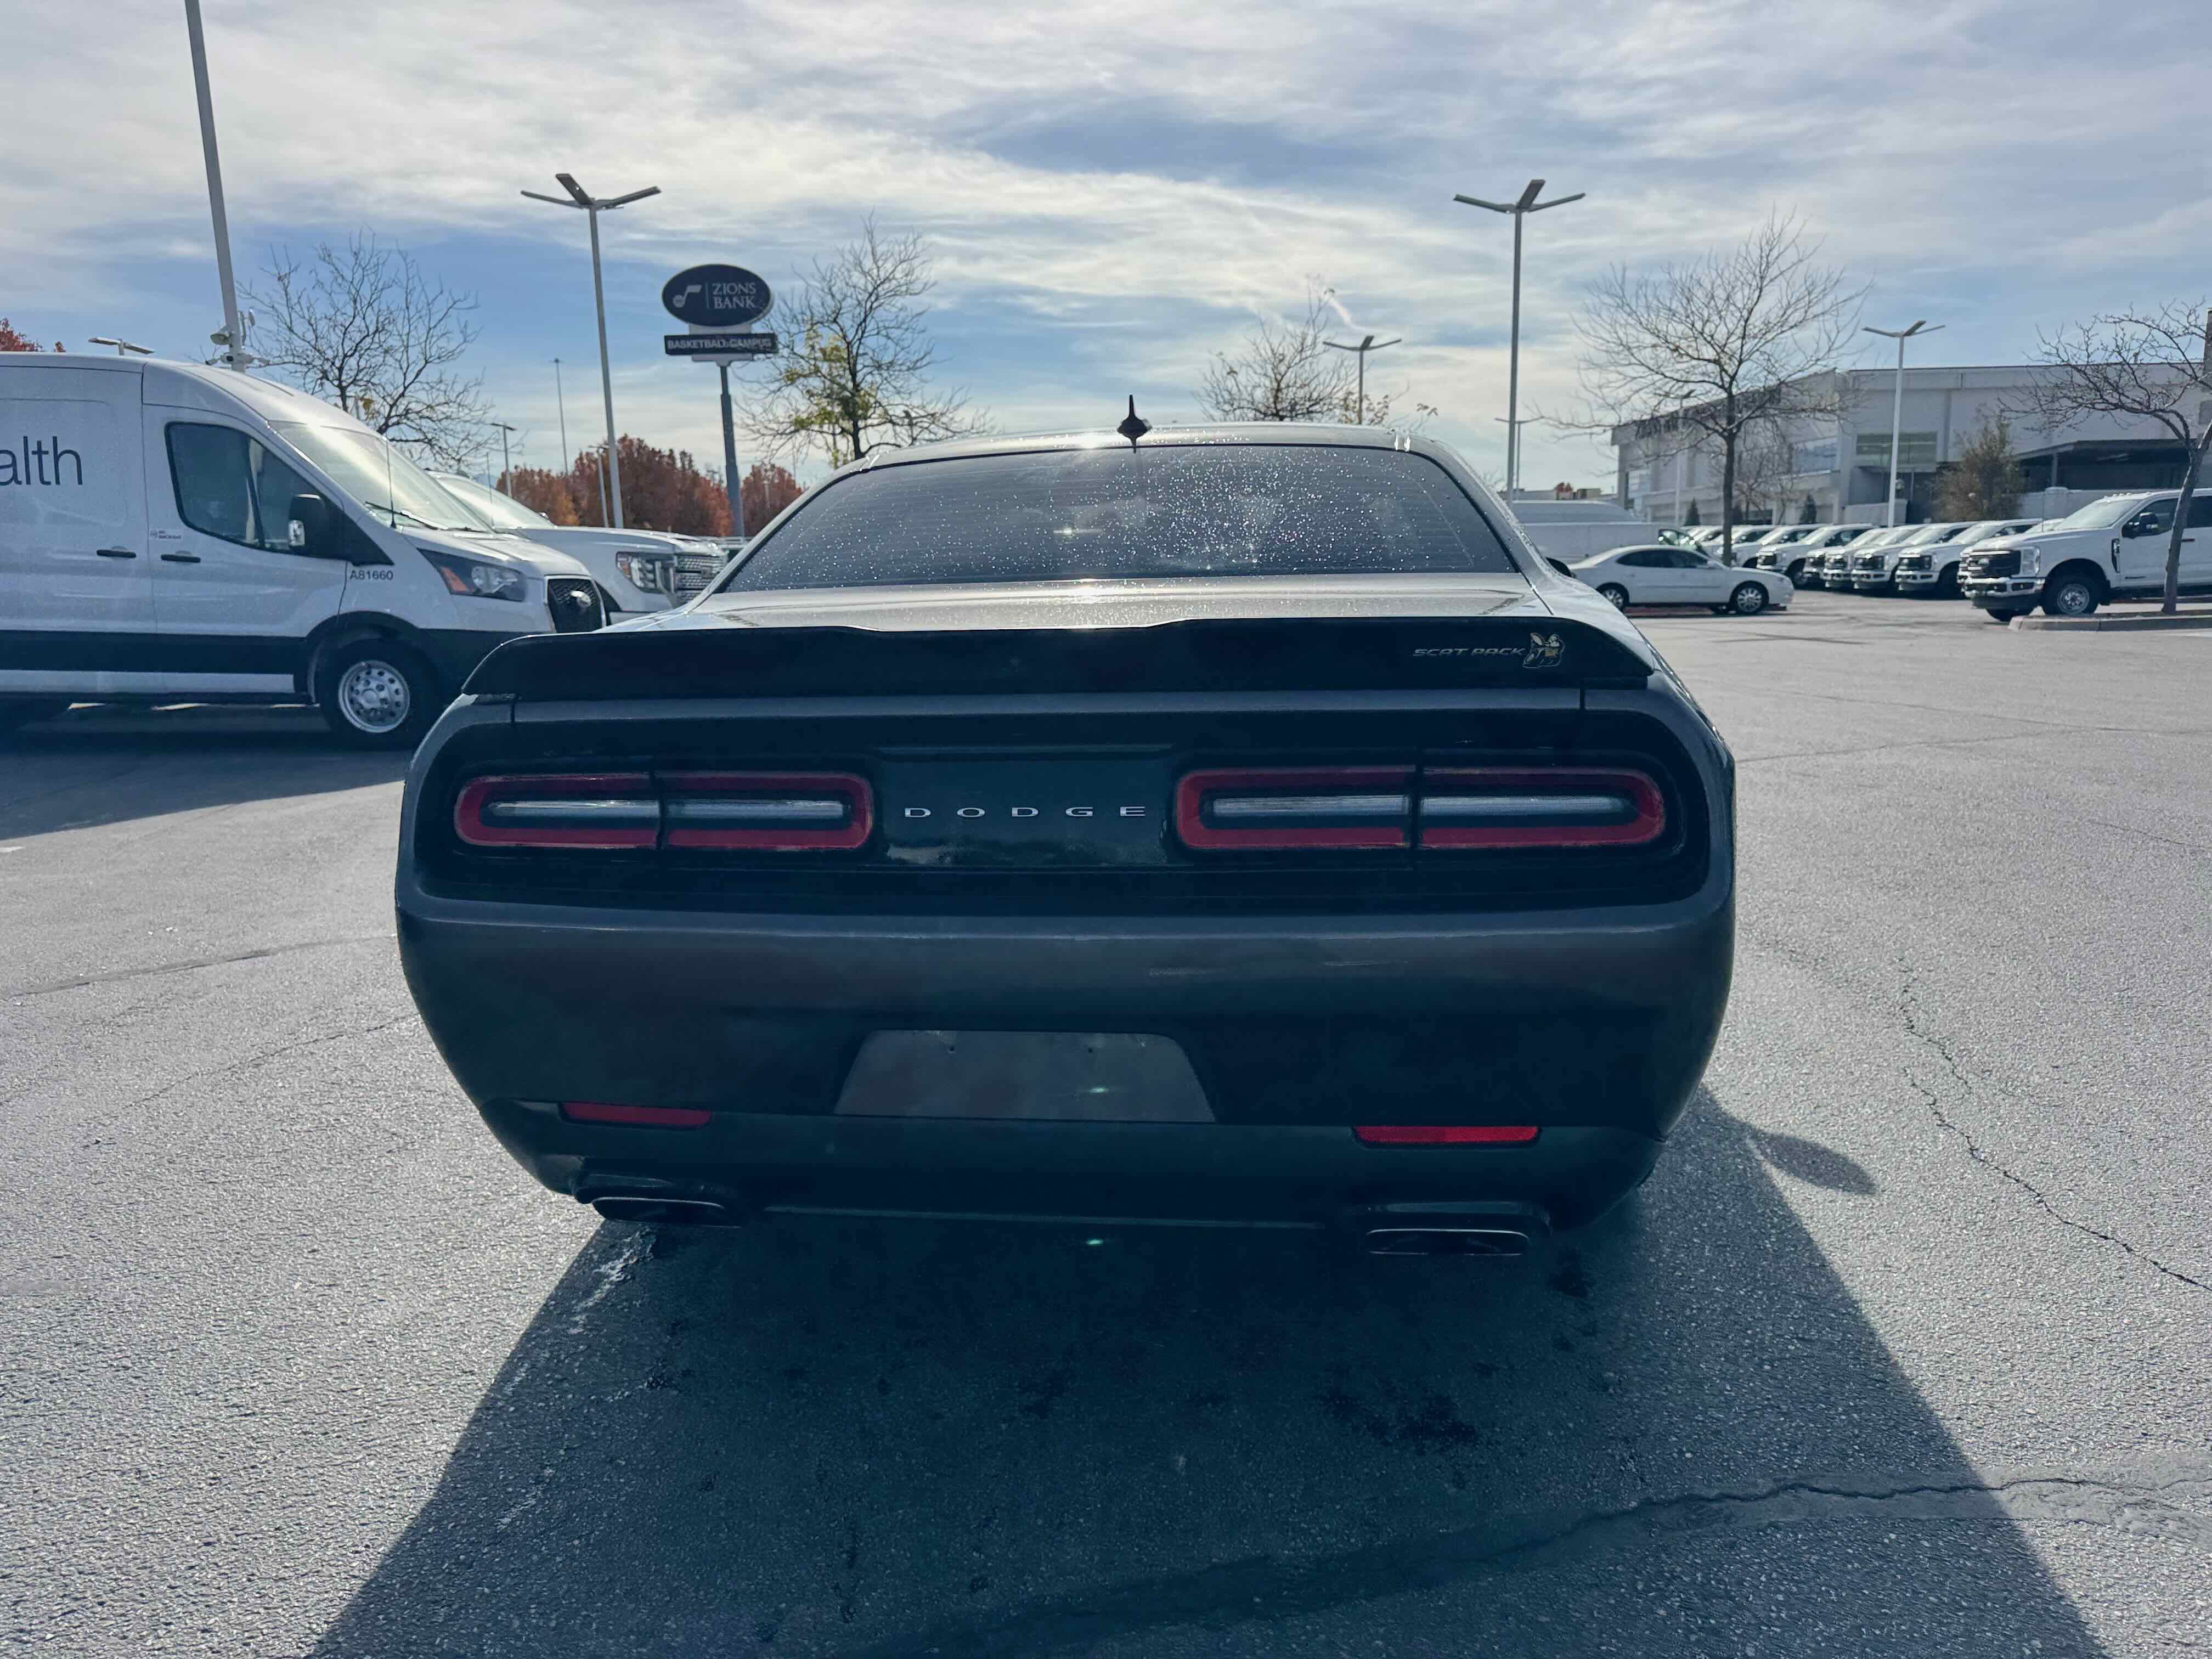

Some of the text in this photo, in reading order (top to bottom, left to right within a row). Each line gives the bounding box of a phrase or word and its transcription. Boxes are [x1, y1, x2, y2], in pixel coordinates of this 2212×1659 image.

[712, 282, 756, 295] ZIONS
[713, 296, 756, 309] BANK
[350, 570, 393, 580] A81660
[1471, 648, 1526, 656] PACK
[904, 806, 1146, 817] DODGE
